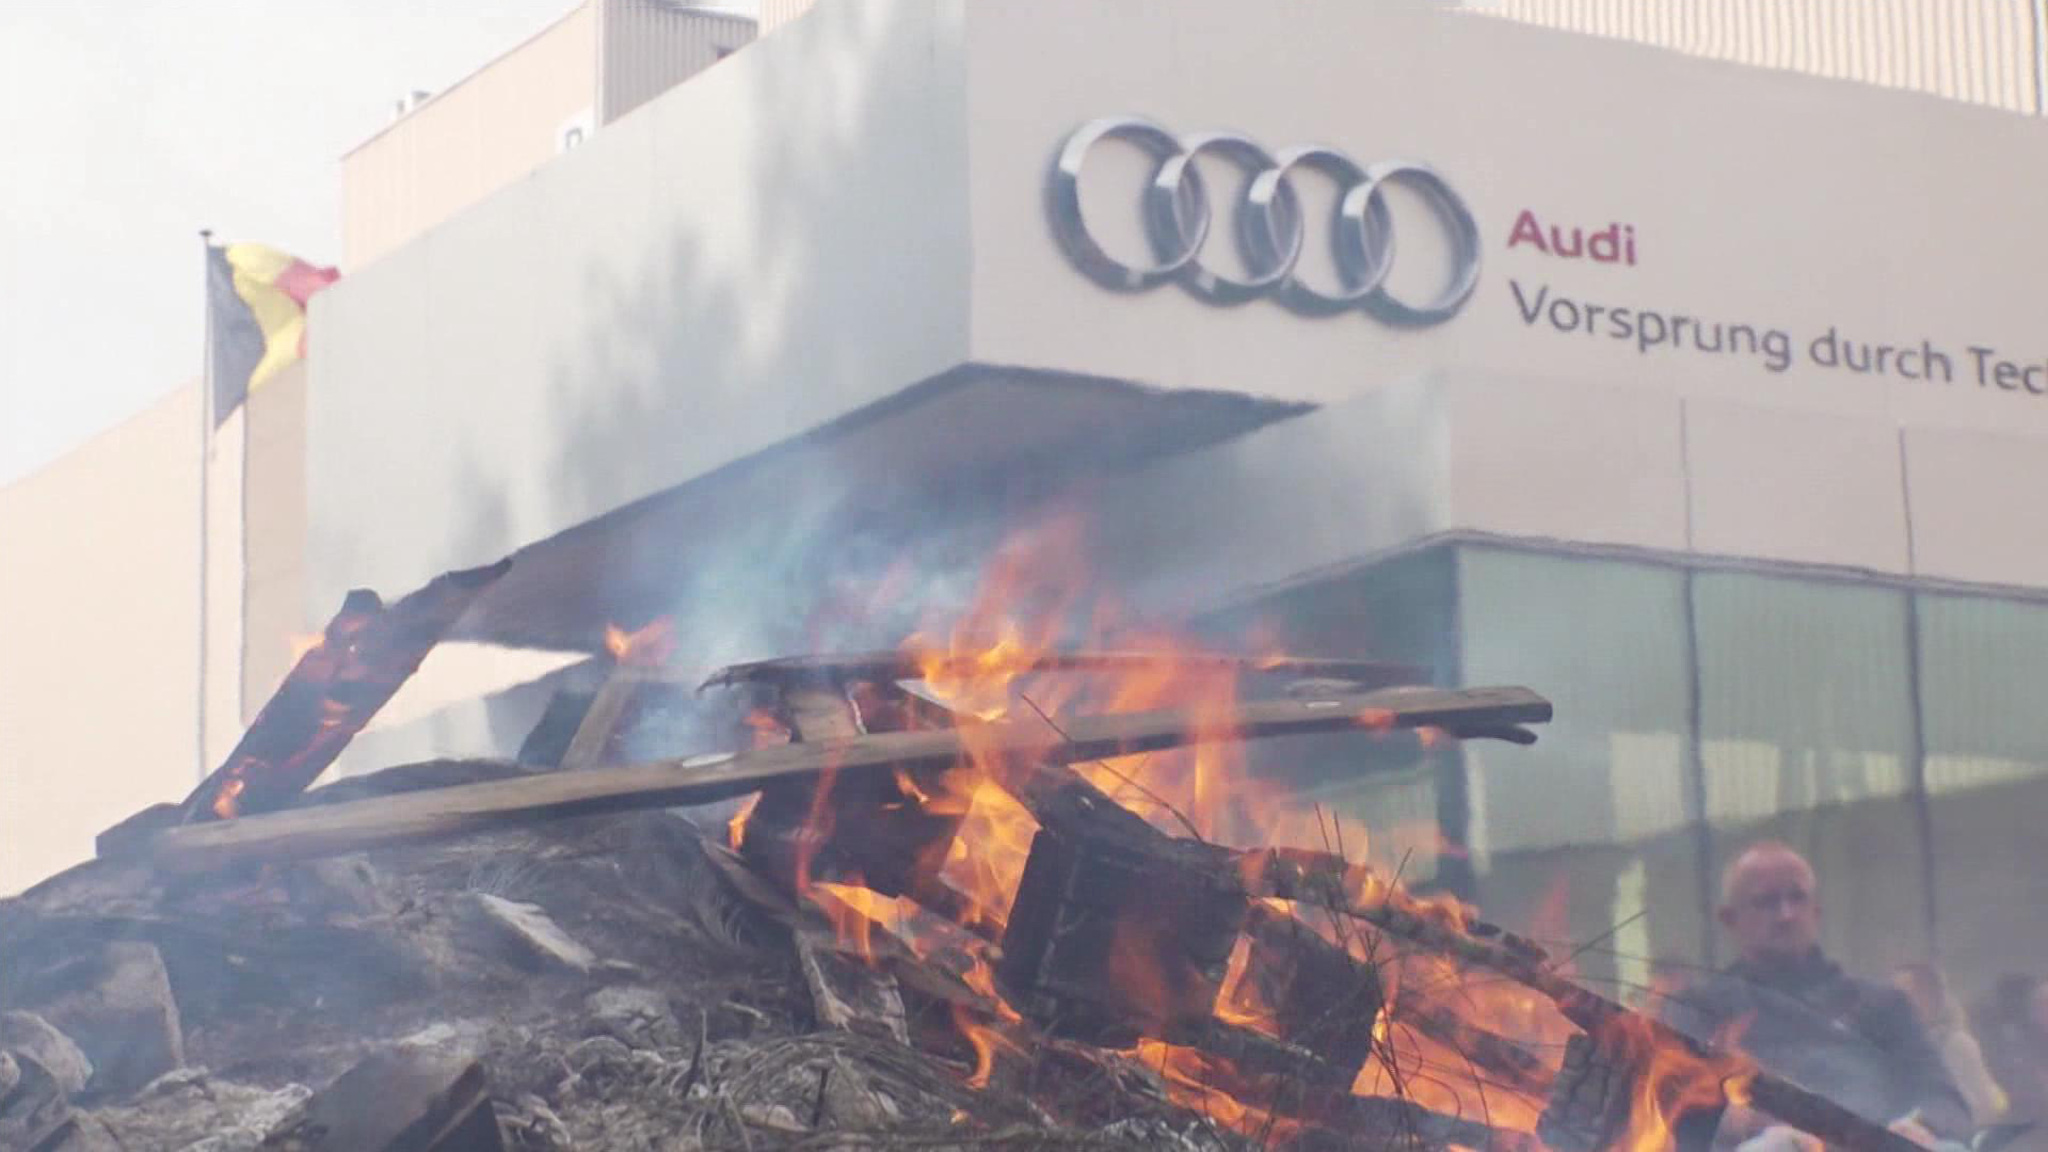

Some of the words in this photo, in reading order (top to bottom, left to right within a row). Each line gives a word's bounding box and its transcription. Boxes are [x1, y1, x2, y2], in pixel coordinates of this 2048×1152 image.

[1506, 208, 1638, 267] Audi
[1508, 279, 1793, 373] Vorsprung
[1807, 327, 1953, 383] durch
[1966, 346, 2048, 395] Tec
